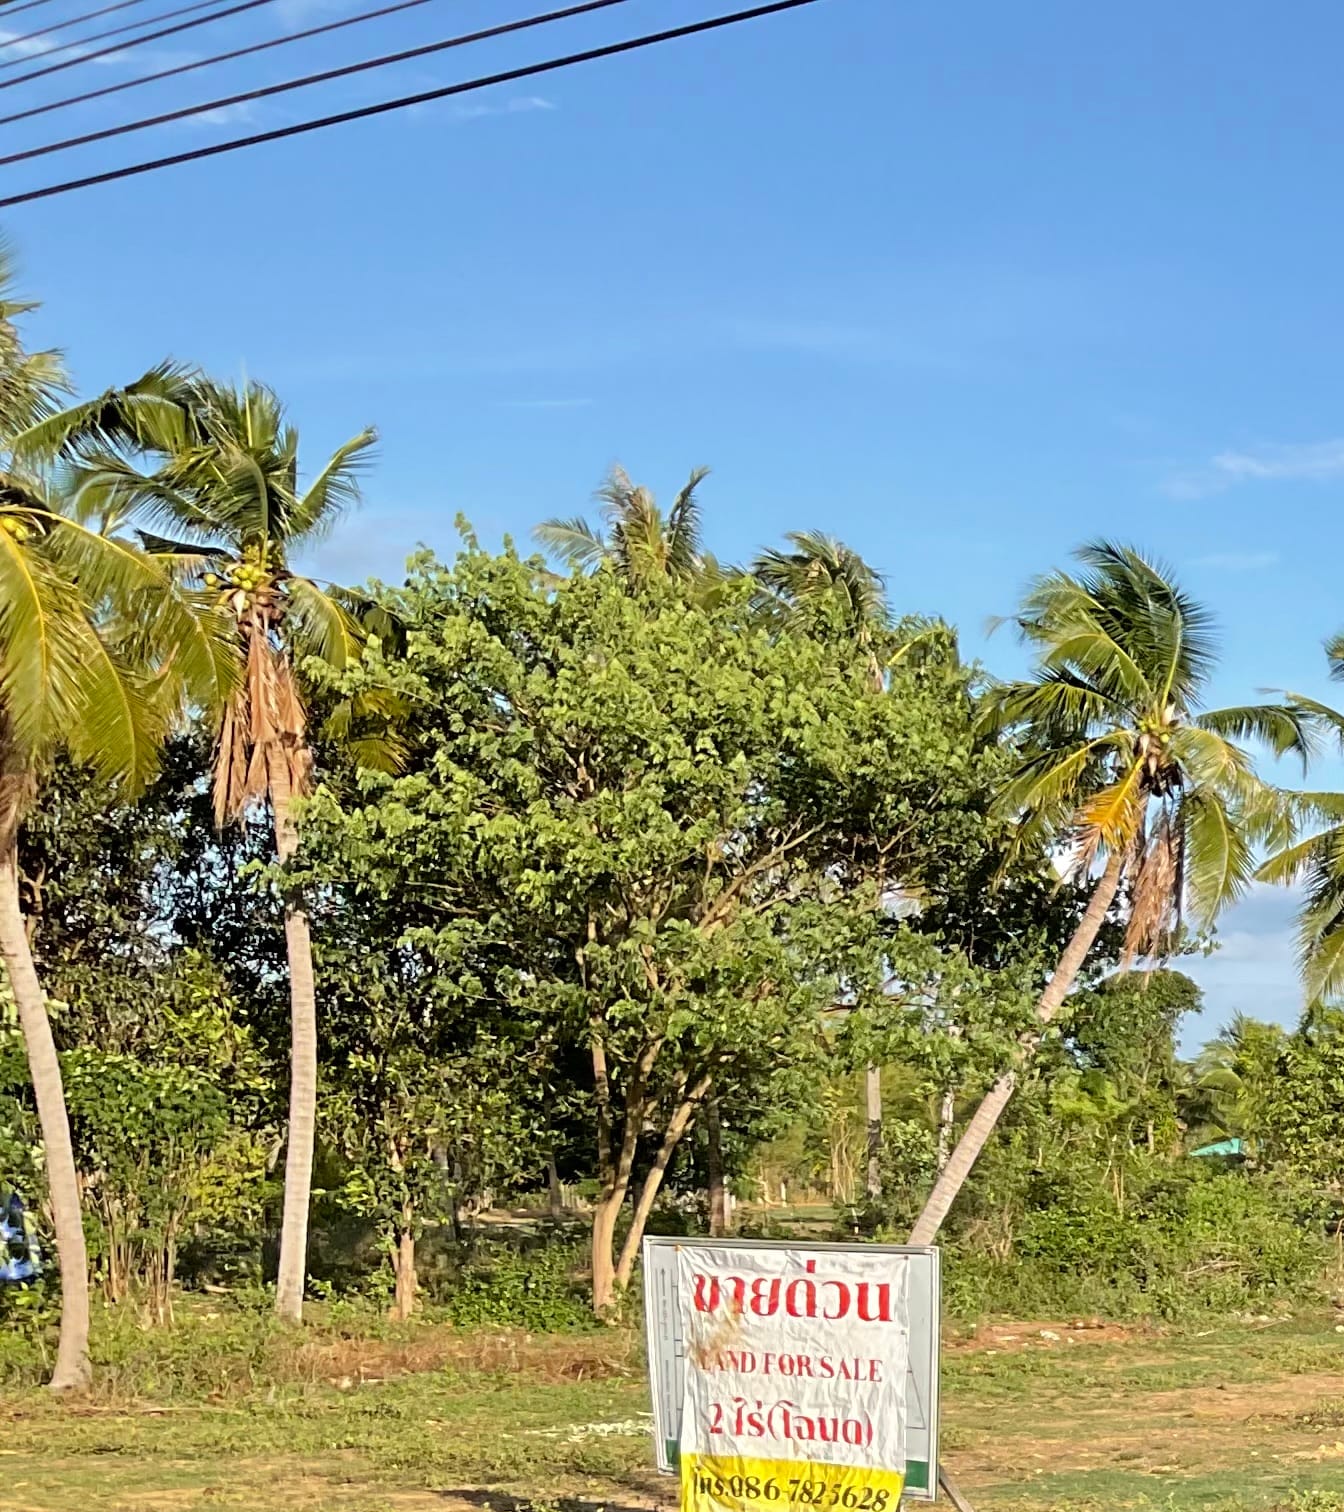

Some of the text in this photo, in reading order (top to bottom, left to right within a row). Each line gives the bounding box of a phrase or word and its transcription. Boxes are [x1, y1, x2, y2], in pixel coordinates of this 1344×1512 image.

[693, 1259, 893, 1322] ขายด่วน
[700, 1350, 883, 1383] LAND FOR SALE
